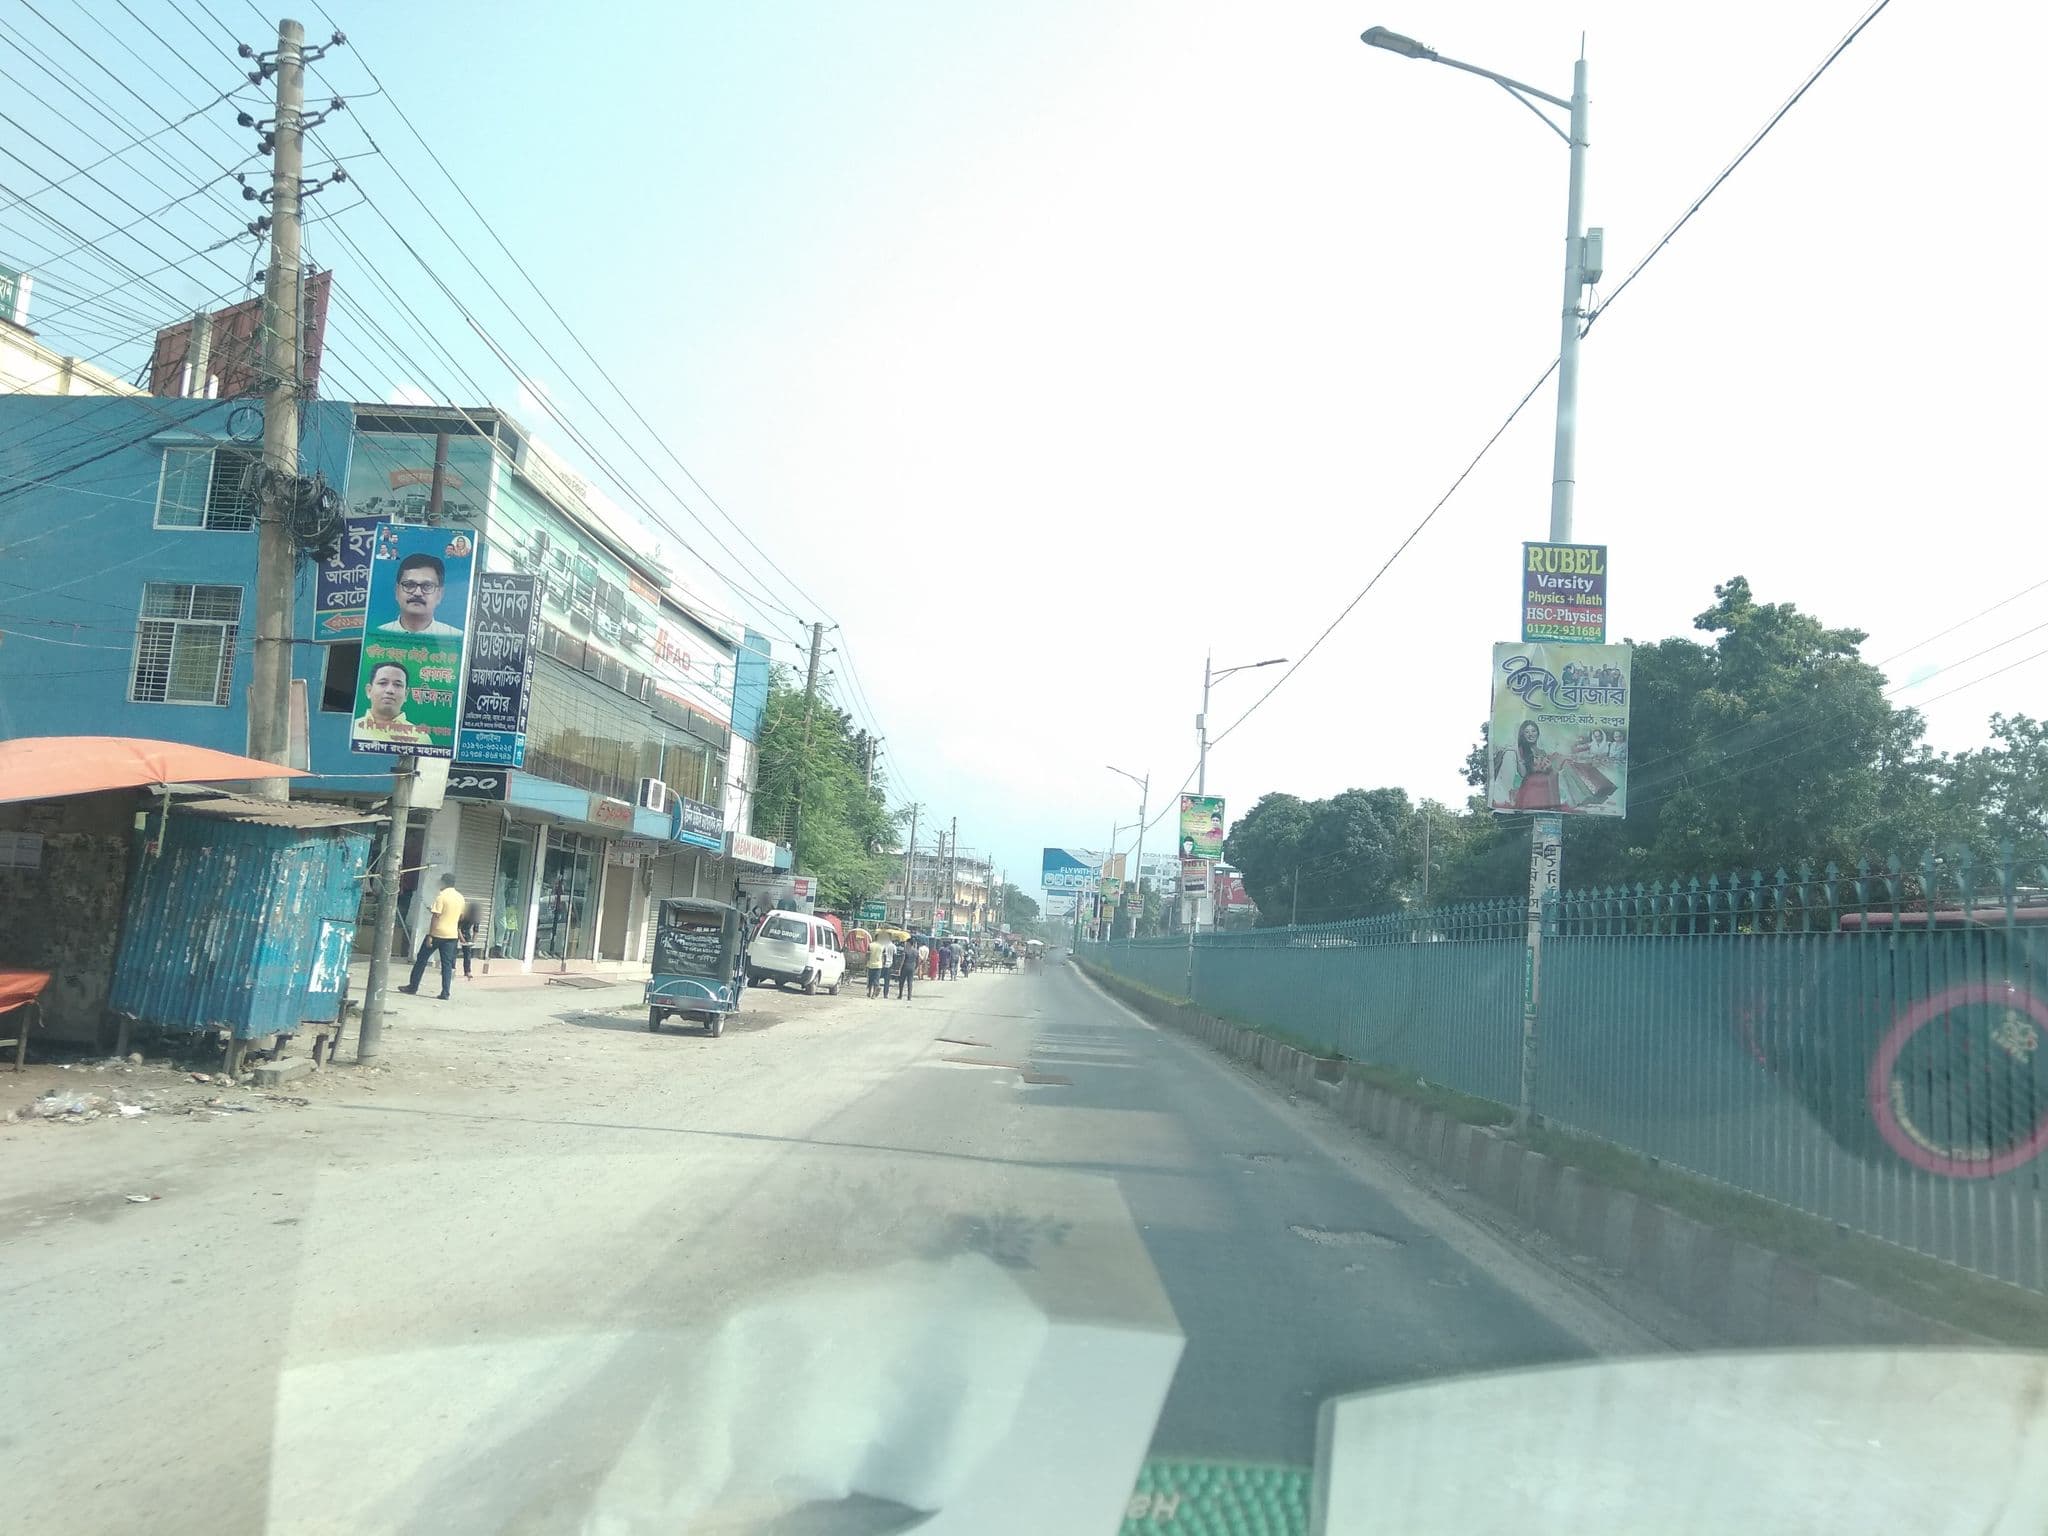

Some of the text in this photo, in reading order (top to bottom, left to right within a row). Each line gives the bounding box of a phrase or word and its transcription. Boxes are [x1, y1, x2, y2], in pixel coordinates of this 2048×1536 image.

[1527, 546, 1604, 575] RUBEL
[325, 565, 371, 585] আবাসি
[1537, 574, 1593, 593] Varsity
[327, 587, 369, 608] হোটে
[480, 579, 531, 619] ইউনিক
[1528, 590, 1565, 605] Physics
[1576, 593, 1602, 606] Math
[1526, 607, 1603, 625] HSC-Physics
[1526, 624, 1602, 637] 01722-931684
[475, 620, 526, 662] ডিজিটাল
[471, 665, 522, 688] ডায়াগনোস্টিক
[476, 690, 511, 713] সেন্টার
[1561, 686, 1627, 706] বাজার
[358, 741, 452, 757] যুবলীগ রংপুর মহানগর
